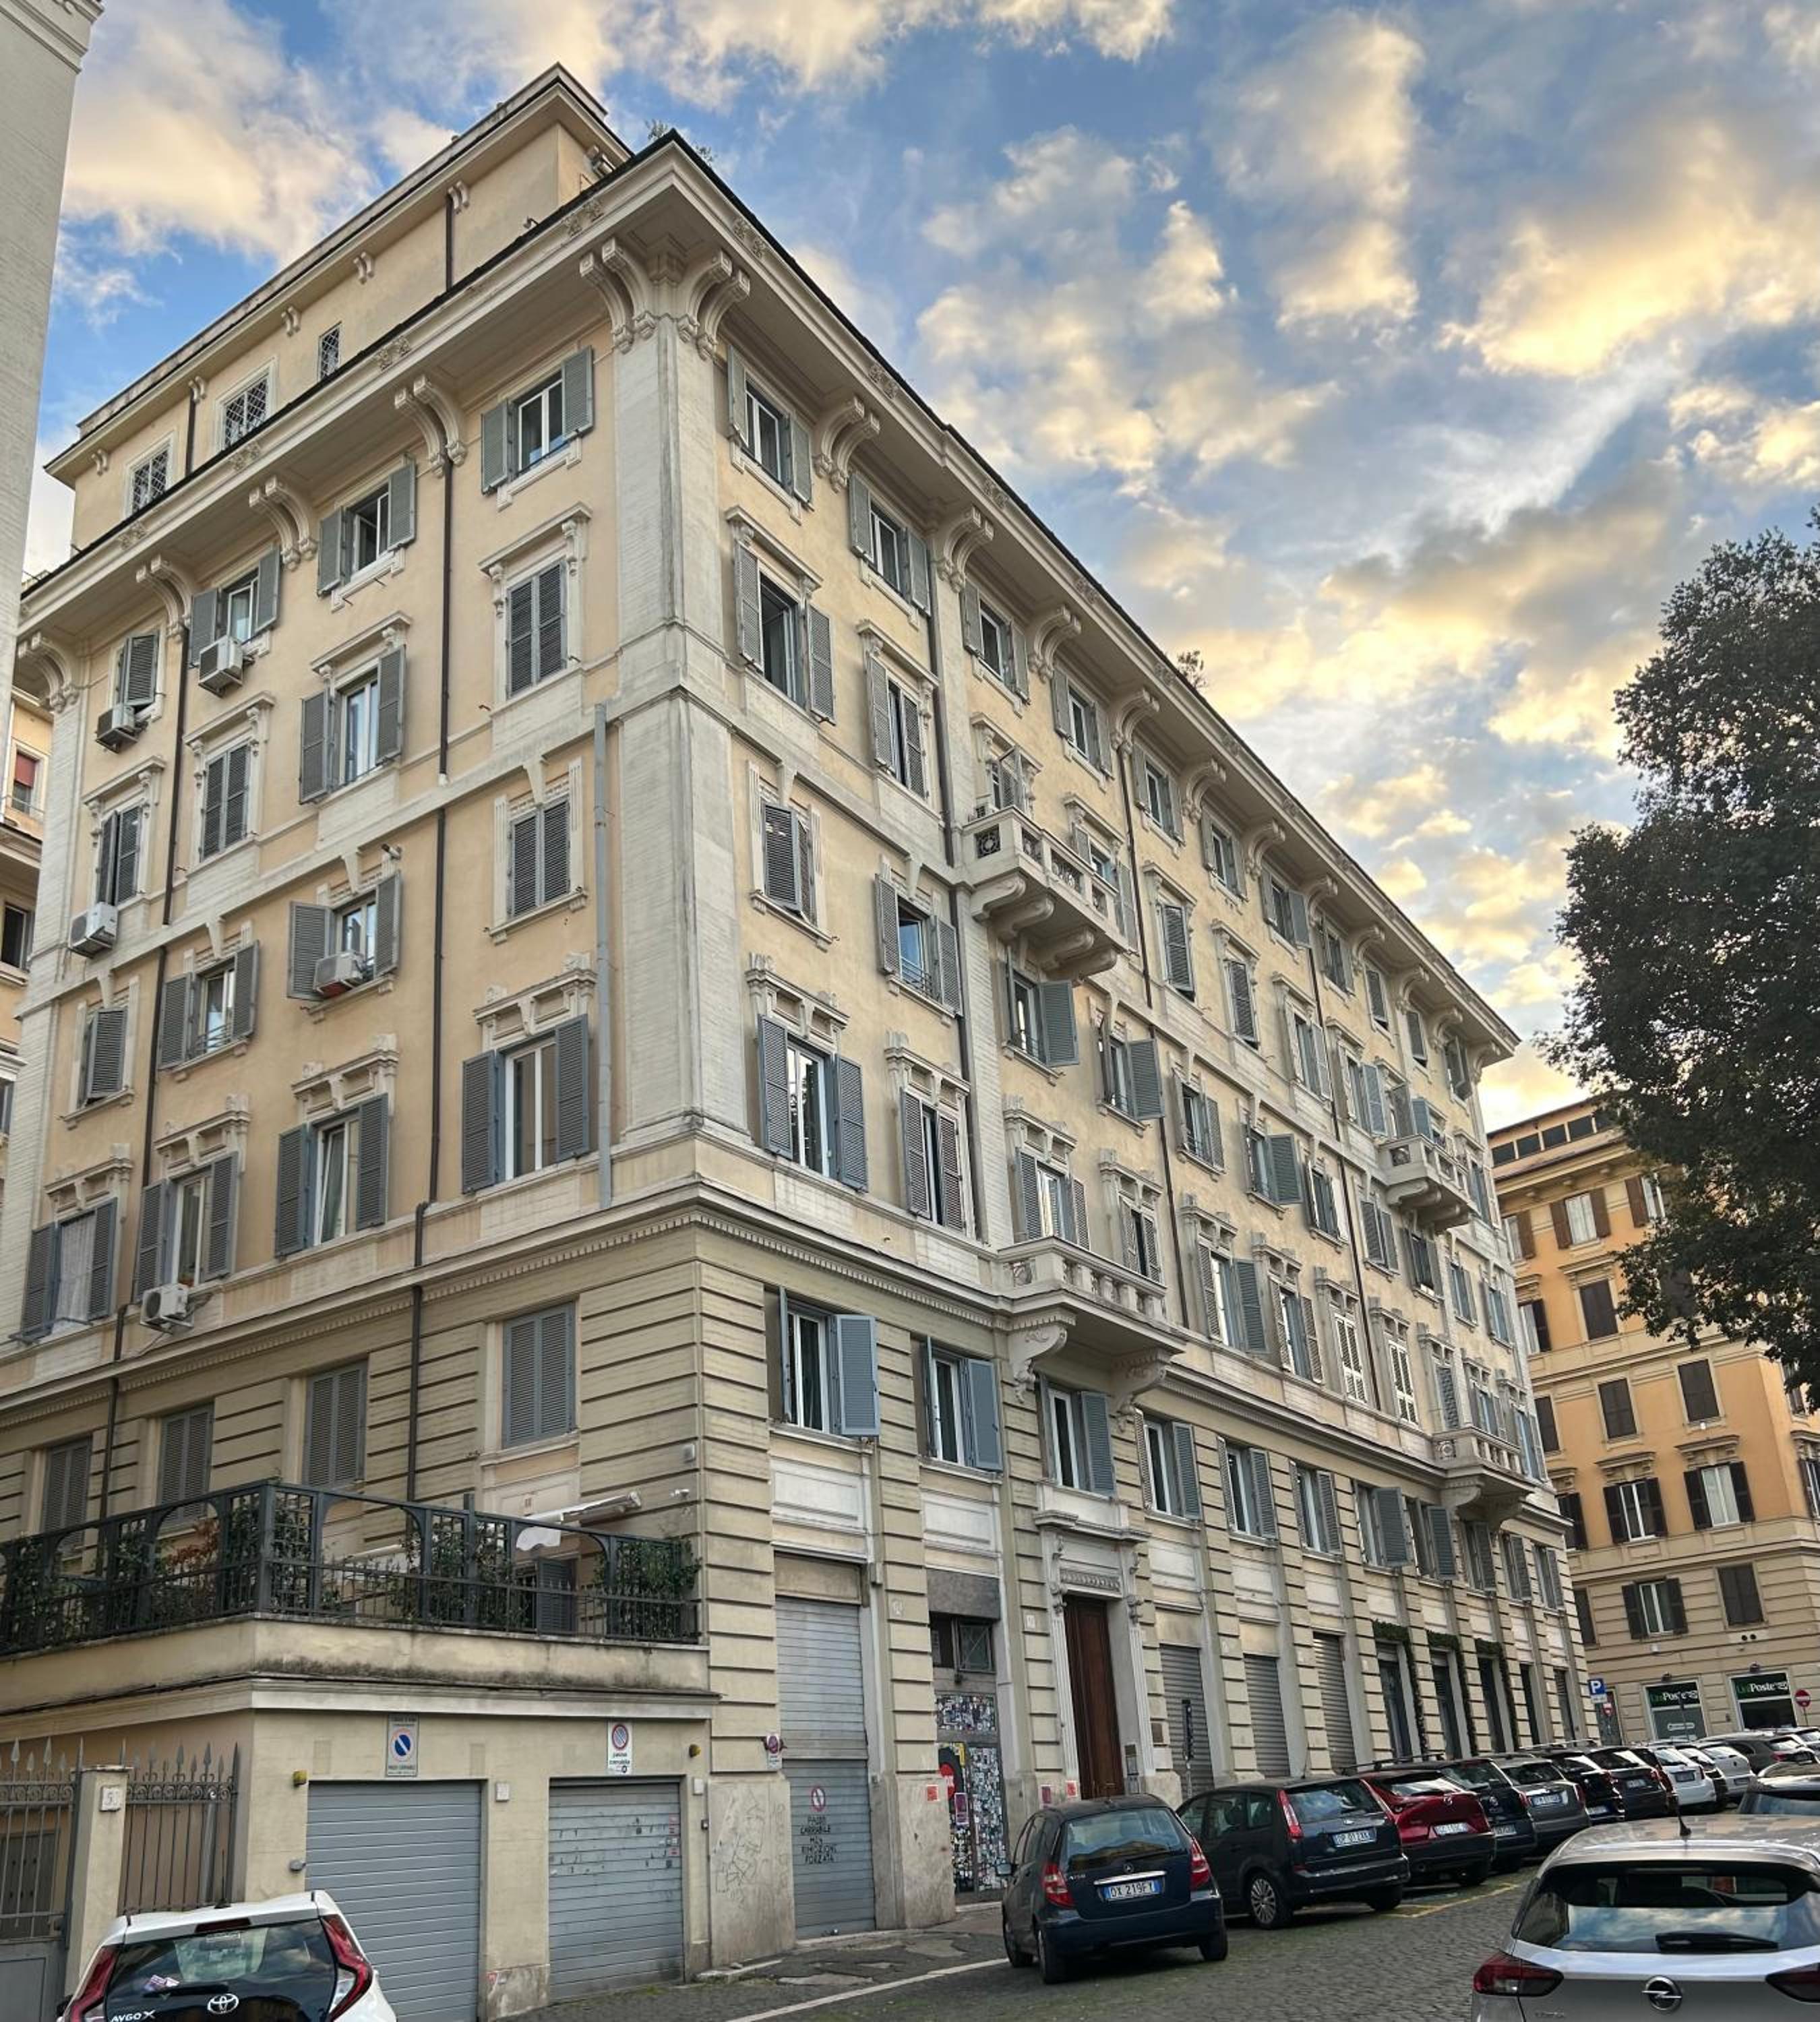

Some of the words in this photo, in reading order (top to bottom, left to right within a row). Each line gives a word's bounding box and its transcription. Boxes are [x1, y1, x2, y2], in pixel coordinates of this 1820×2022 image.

[1590, 1680, 1602, 1694] P
[800, 1825, 831, 1834] CARRABILE
[805, 1854, 835, 1864] FORZATA
[1111, 1887, 1122, 1897] DX
[111, 2012, 142, 2022] AYGO
[141, 2009, 156, 2021] X
